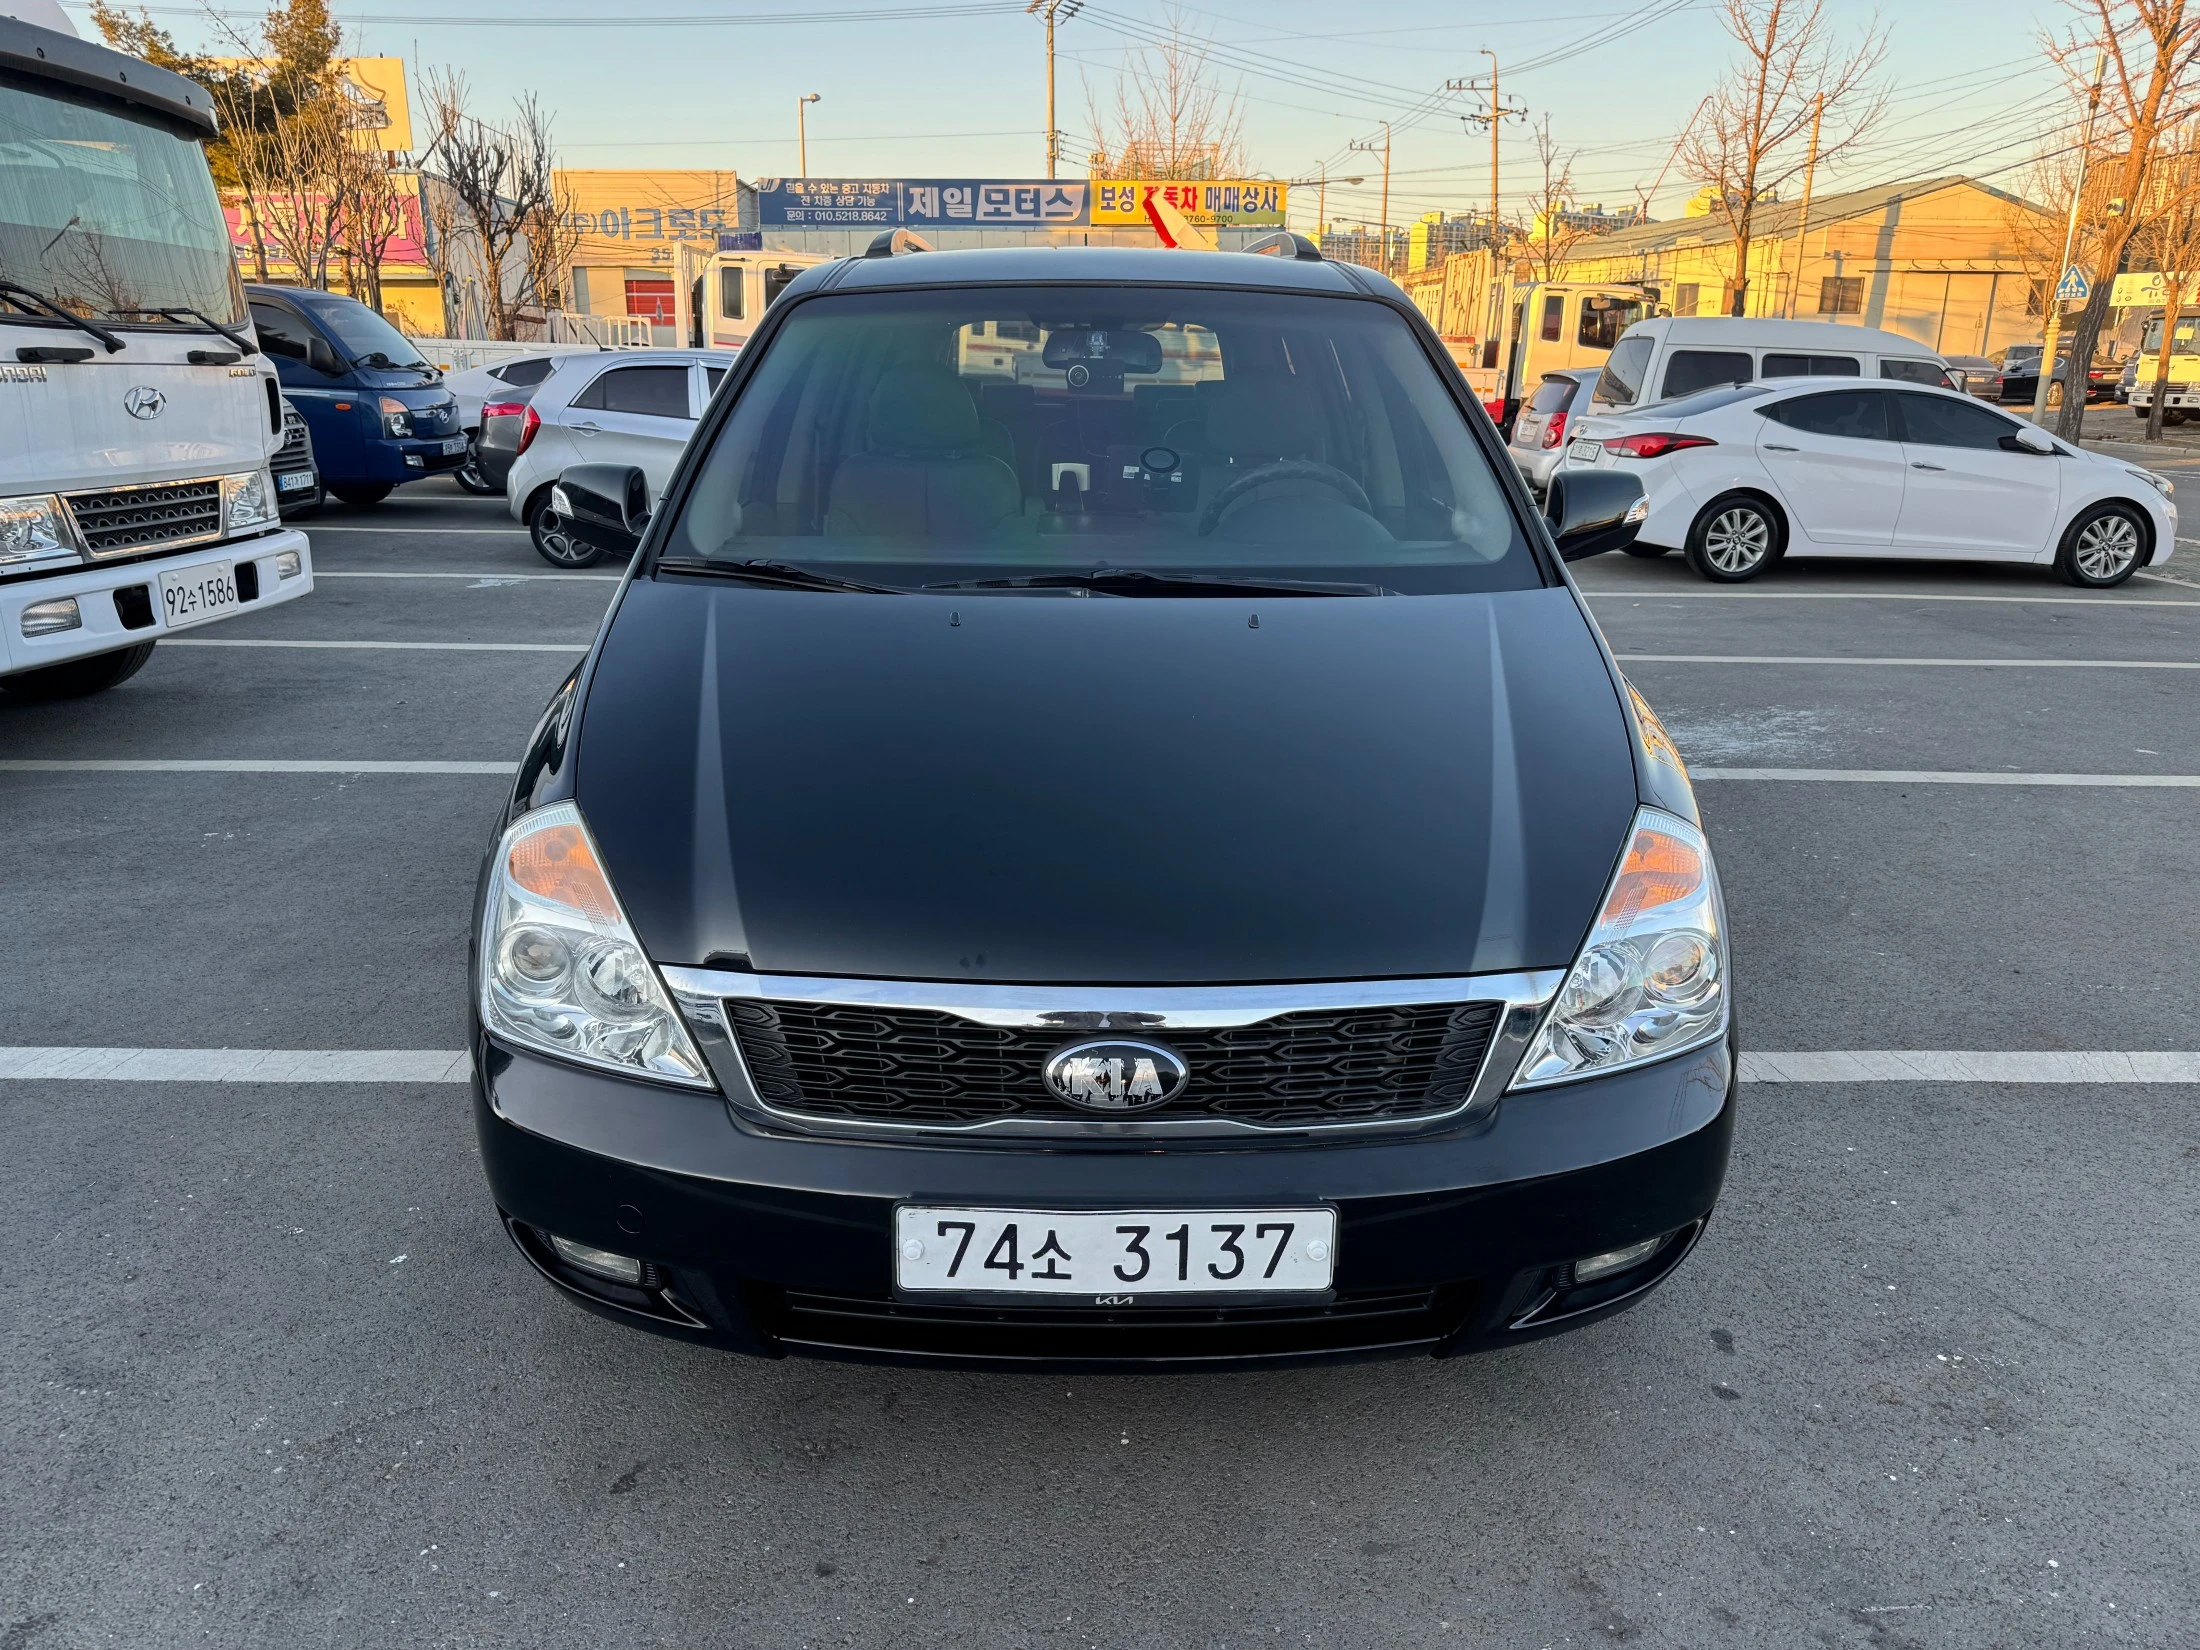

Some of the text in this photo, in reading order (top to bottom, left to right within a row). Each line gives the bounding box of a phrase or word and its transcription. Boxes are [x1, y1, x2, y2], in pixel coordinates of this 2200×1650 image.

[785, 183, 804, 194] 믿을
[808, 183, 817, 194] 수
[821, 183, 839, 194] 있는
[842, 183, 859, 194] 중고
[801, 195, 876, 206] 전 차종 상담 가능
[908, 187, 1074, 218] 제일 모터스
[1100, 186, 1135, 213] 보성
[1205, 186, 1278, 213] 매매상사
[787, 210, 804, 221] 문의
[815, 211, 887, 222] 010.5218.8642
[0, 366, 47, 382] NDAI
[1070, 1057, 1163, 1095] KIA
[937, 1220, 1295, 1282] 74소 3137
